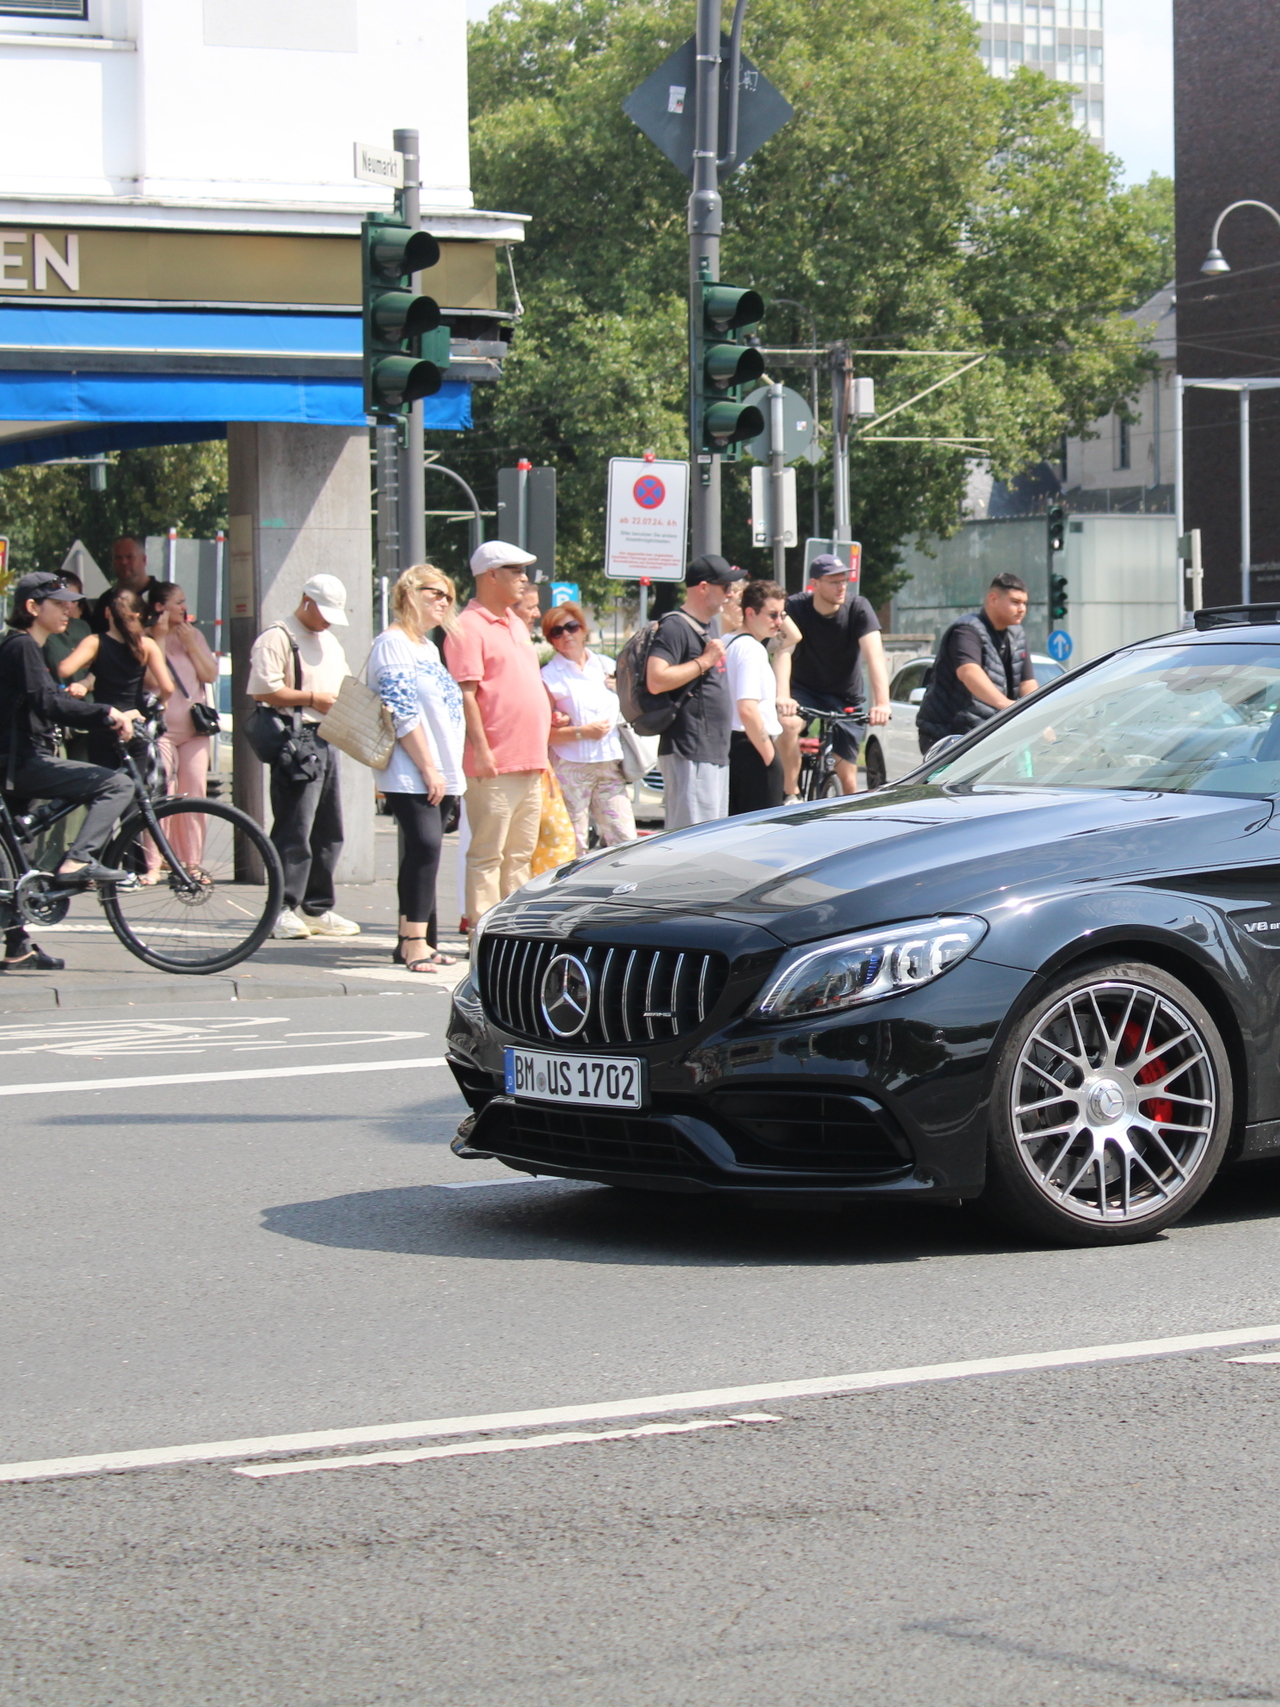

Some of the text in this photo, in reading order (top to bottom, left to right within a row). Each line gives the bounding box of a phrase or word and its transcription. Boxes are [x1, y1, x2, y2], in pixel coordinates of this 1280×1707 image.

[362, 150, 397, 178] Neumarkt
[0, 232, 80, 291] EN
[1244, 921, 1269, 933] V8
[515, 1055, 535, 1092] BM
[547, 1060, 572, 1096] US
[577, 1062, 635, 1100] 1702
